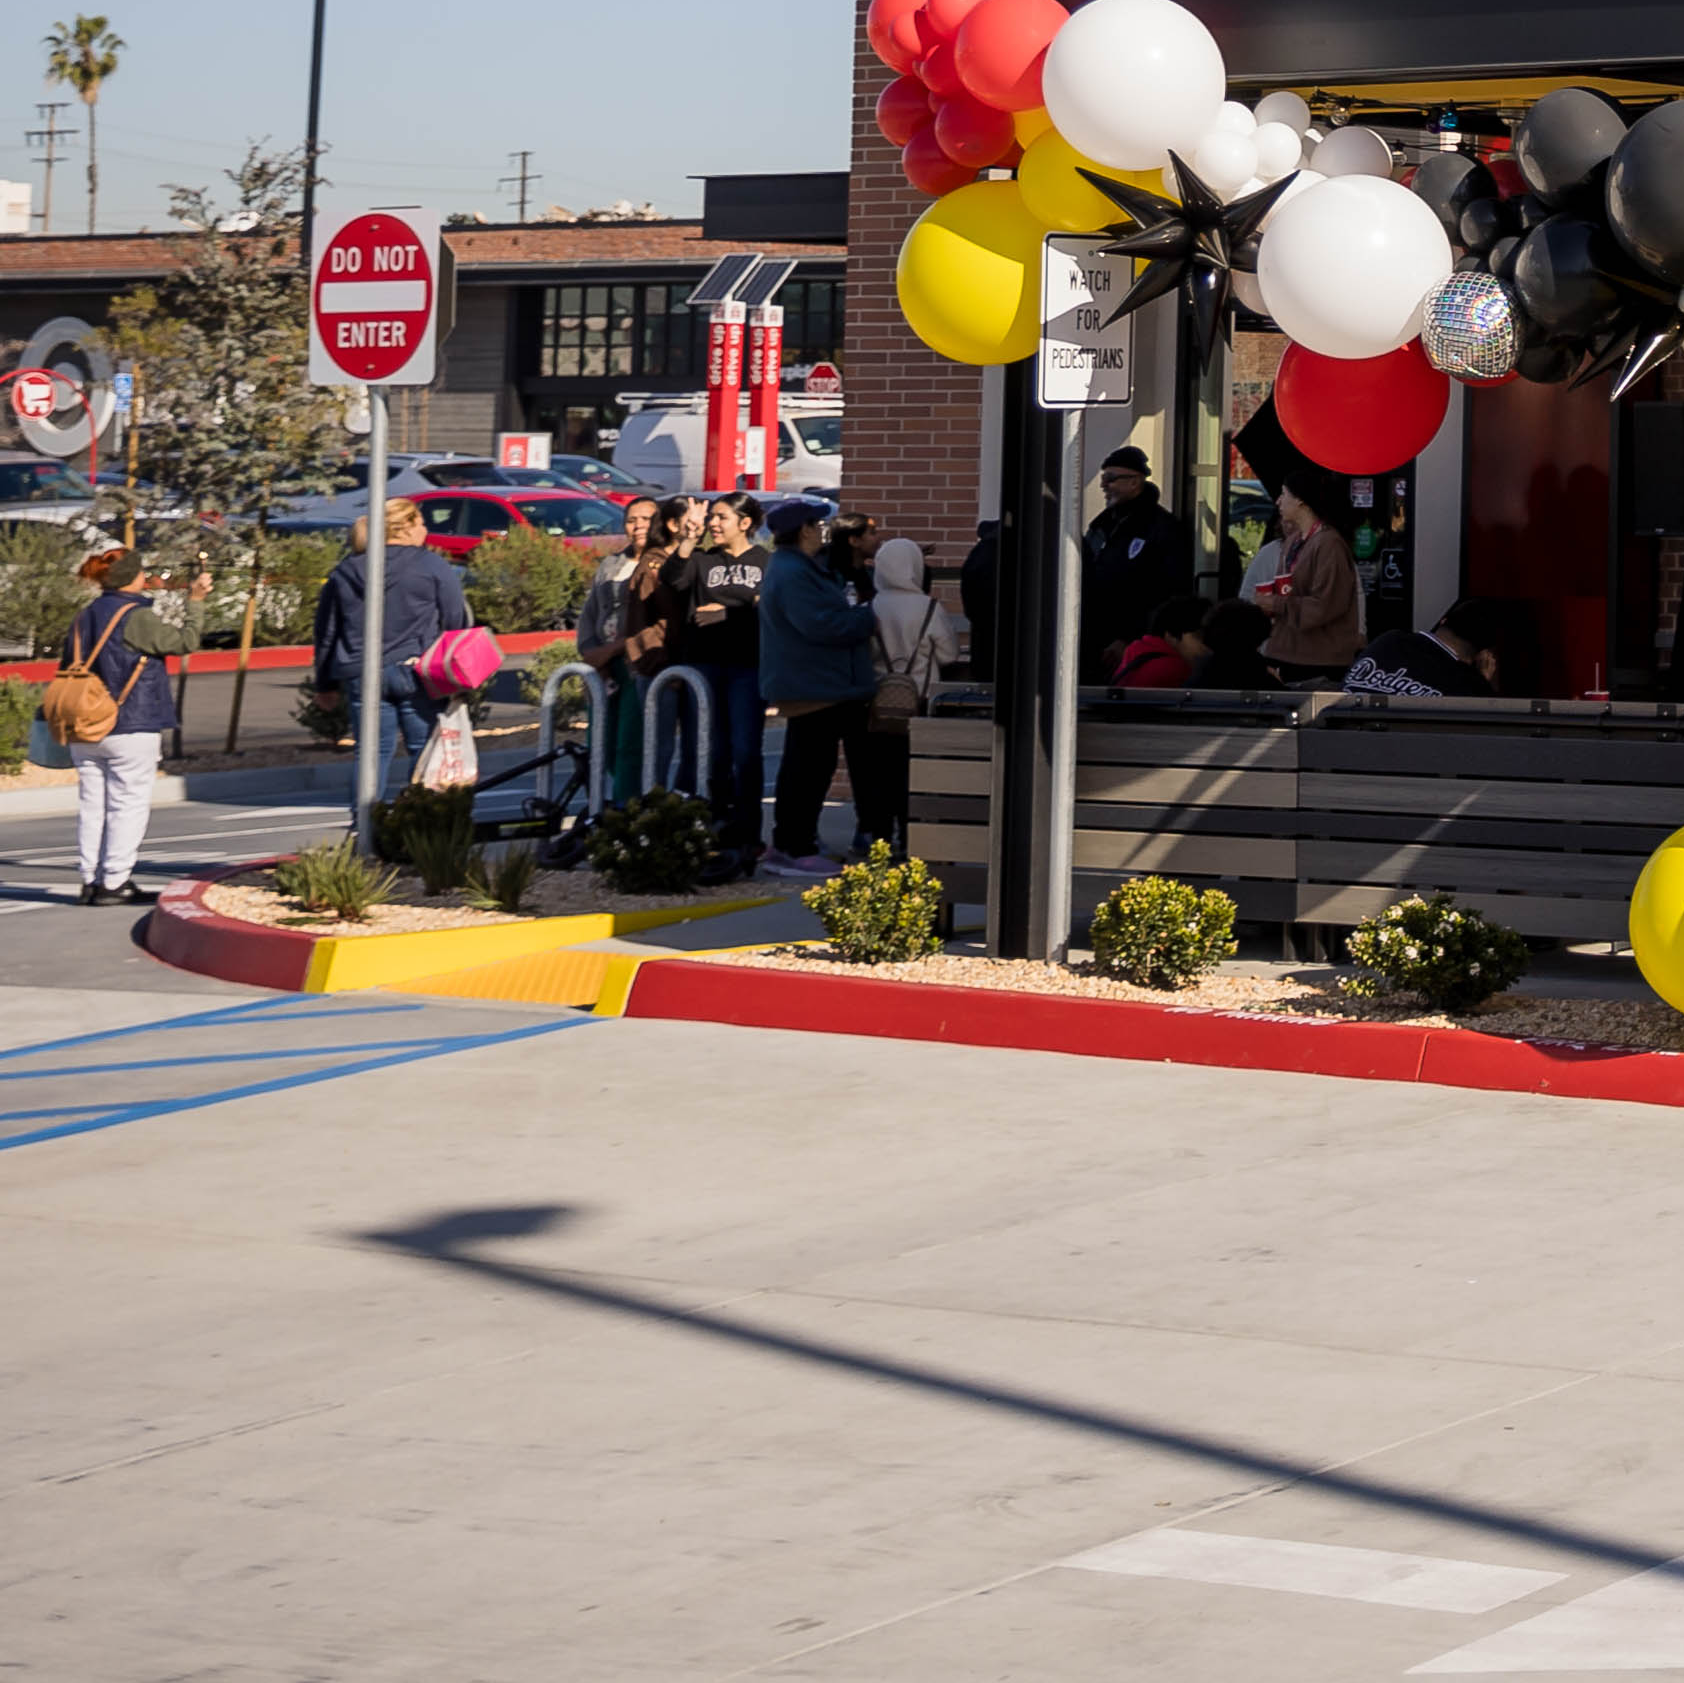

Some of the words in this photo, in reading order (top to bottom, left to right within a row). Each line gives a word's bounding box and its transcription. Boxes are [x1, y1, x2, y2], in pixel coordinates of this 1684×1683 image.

[331, 246, 362, 274] DO
[373, 245, 419, 273] NOT
[1068, 269, 1112, 292] WATCH
[1076, 308, 1101, 331] FOR
[337, 321, 407, 349] ENTER
[729, 324, 742, 346] up
[709, 347, 724, 386] drive
[726, 347, 739, 386] drive
[765, 348, 778, 385] drive
[1052, 347, 1125, 370] PEDESTRIANS
[808, 377, 840, 392] STOP
